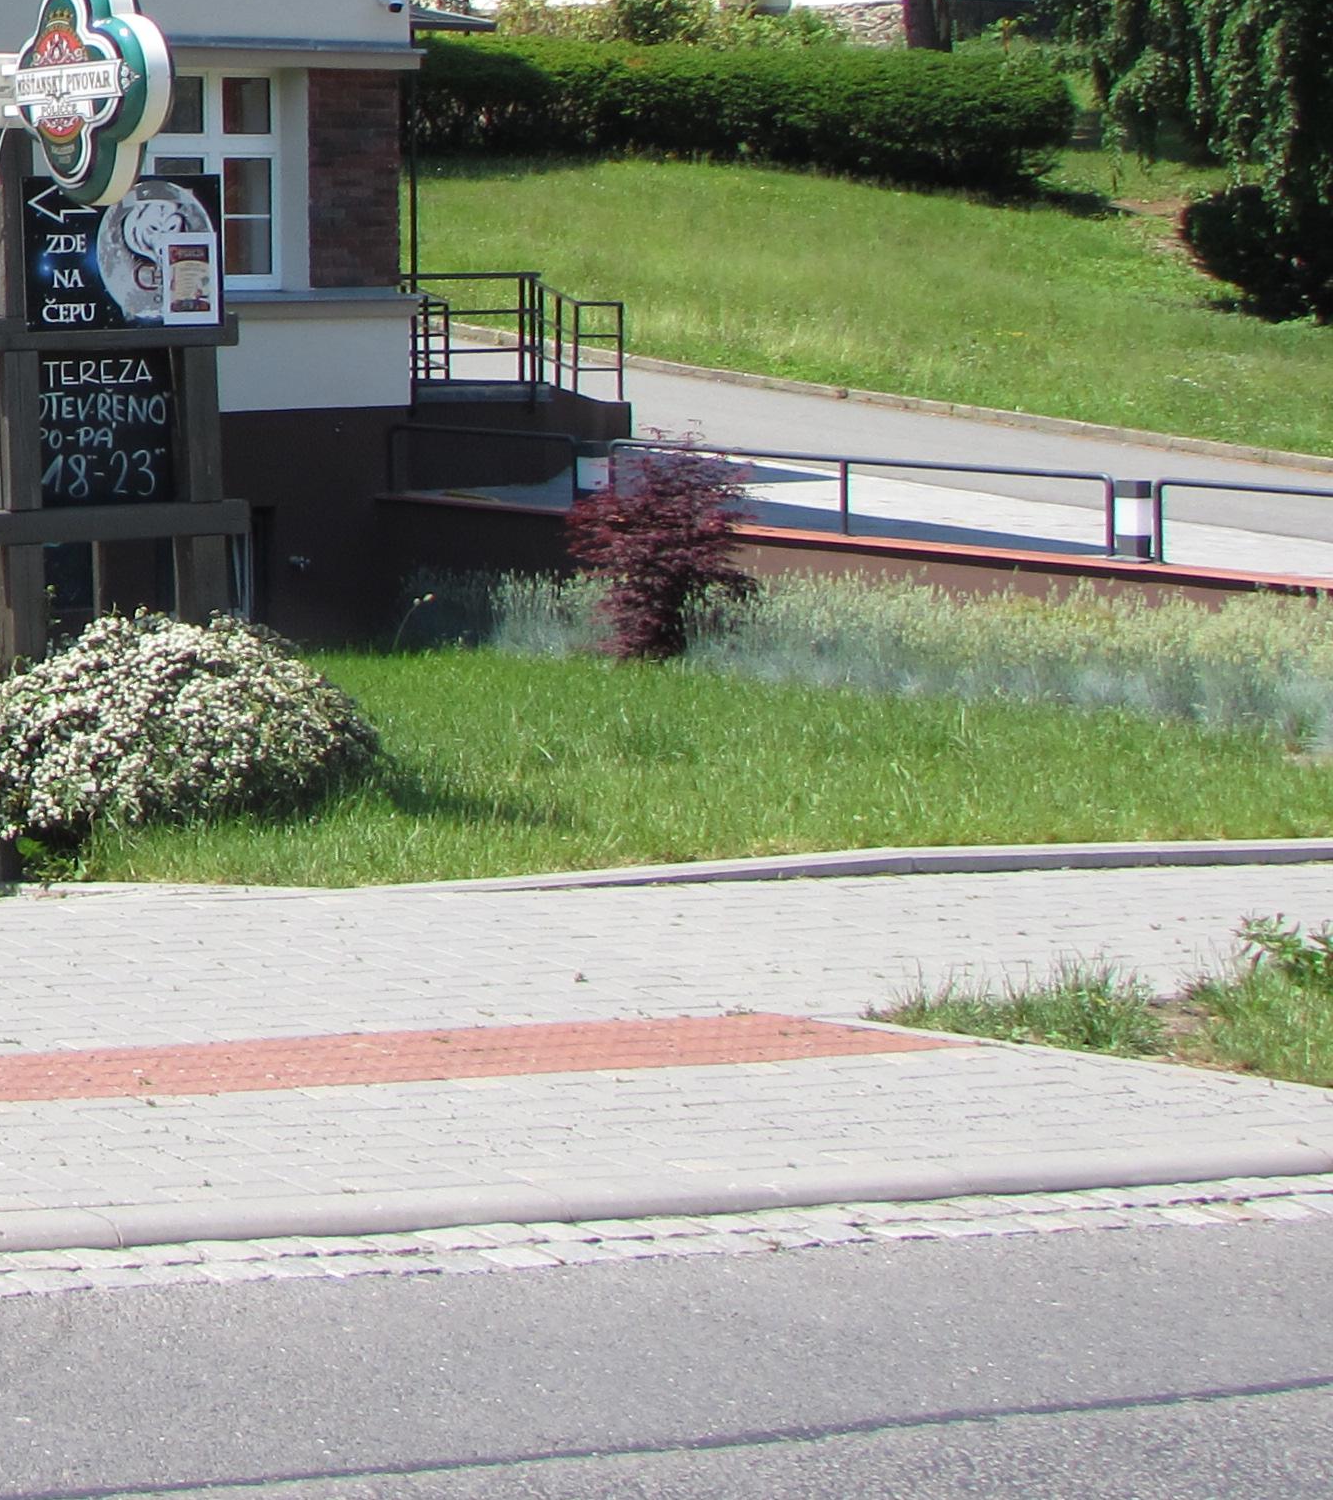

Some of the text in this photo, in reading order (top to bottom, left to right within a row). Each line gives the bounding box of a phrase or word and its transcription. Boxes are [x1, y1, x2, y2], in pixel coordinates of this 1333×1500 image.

[65, 70, 112, 92] PIVOVAR
[46, 233, 87, 254] ZDE
[52, 268, 84, 289] NA
[42, 298, 96, 324] ČEPU
[42, 358, 153, 388] TEREZA
